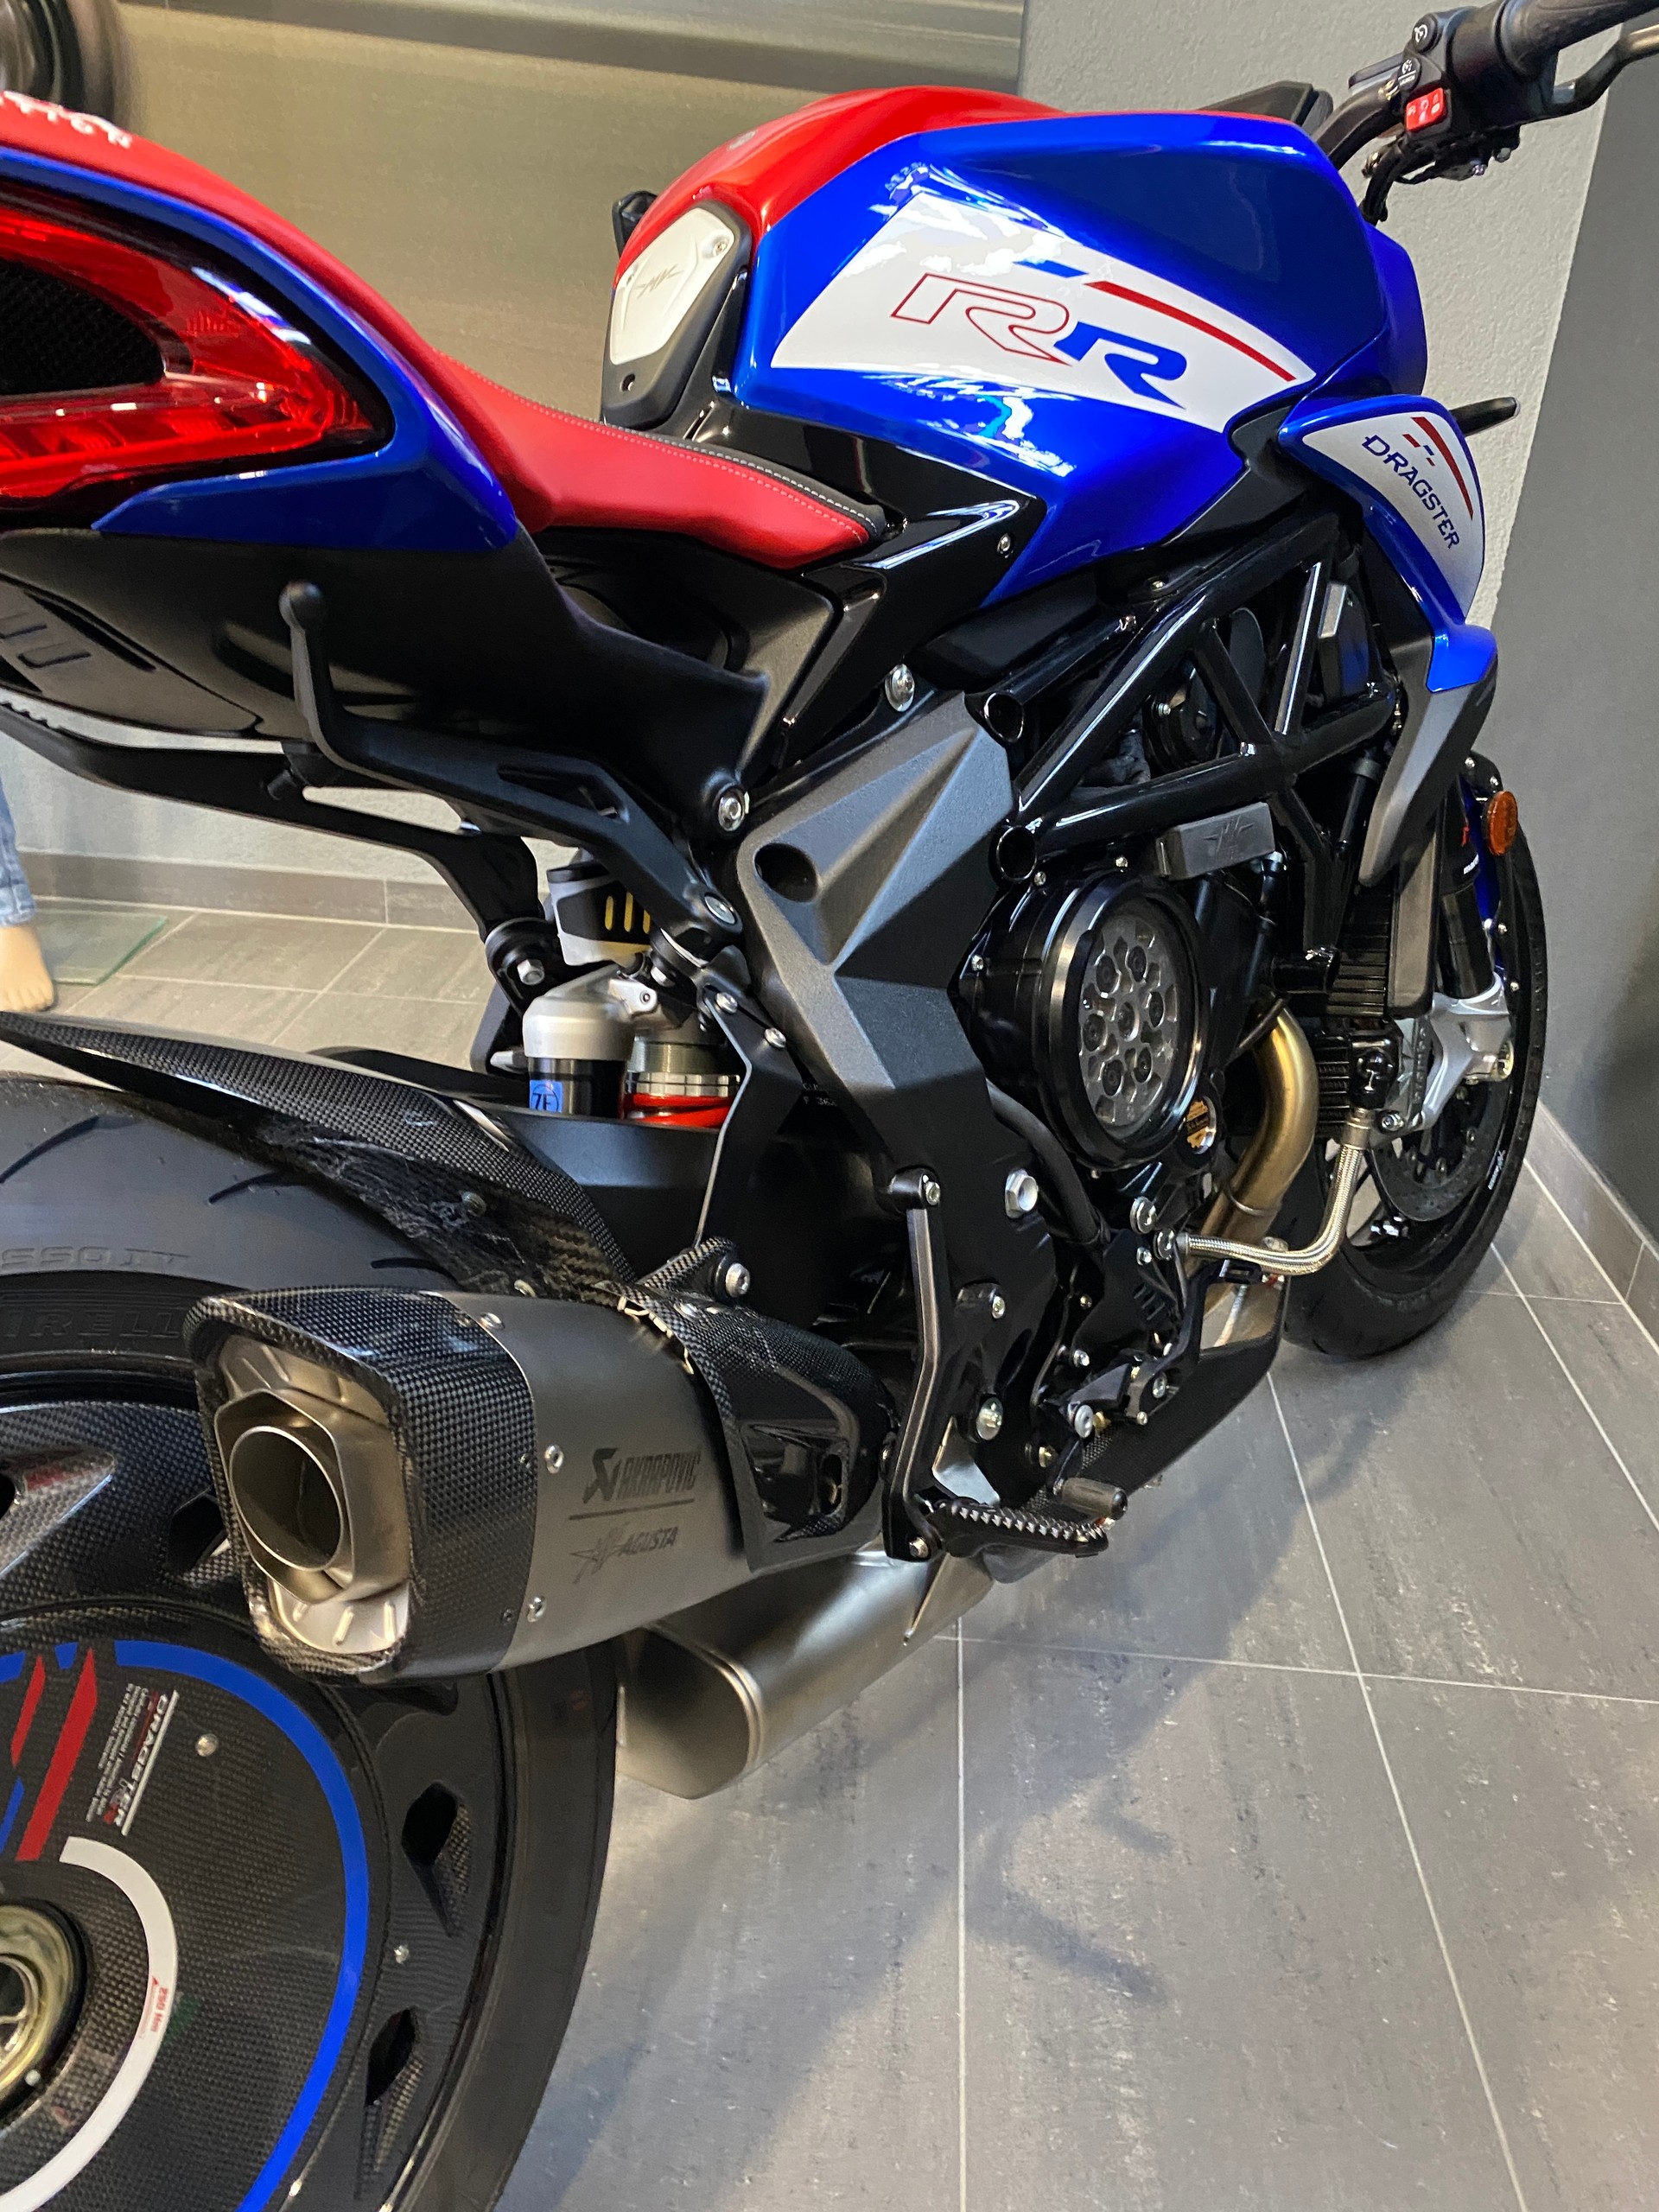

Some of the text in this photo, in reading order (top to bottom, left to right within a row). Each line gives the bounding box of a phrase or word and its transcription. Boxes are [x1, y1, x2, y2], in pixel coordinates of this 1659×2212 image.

[890, 272, 1188, 410] RR
[1361, 434, 1460, 550] DRAGSTER
[3, 1307, 182, 1338] IRELL
[113, 1694, 168, 1827] DRAGSTER
